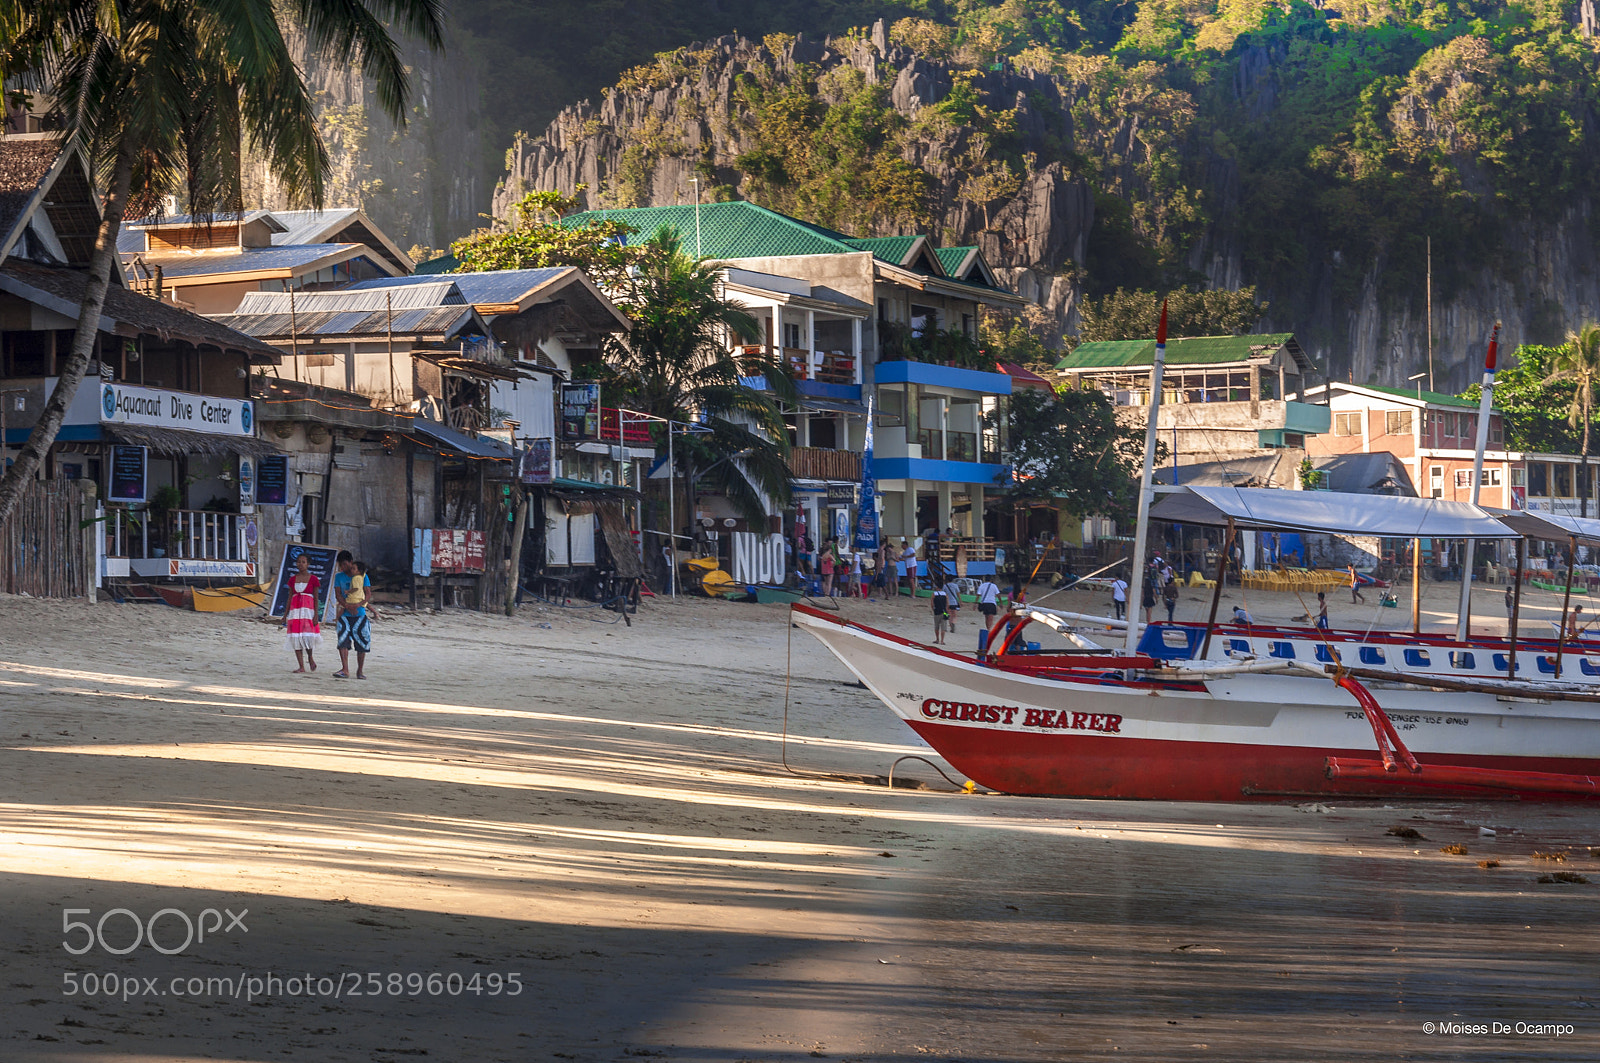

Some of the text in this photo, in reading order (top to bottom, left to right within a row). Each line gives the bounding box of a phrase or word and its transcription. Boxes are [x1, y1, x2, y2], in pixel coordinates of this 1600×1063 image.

[115, 390, 232, 425] Aquanaut Dive Center
[920, 698, 1124, 733] CHRIST BEARER
